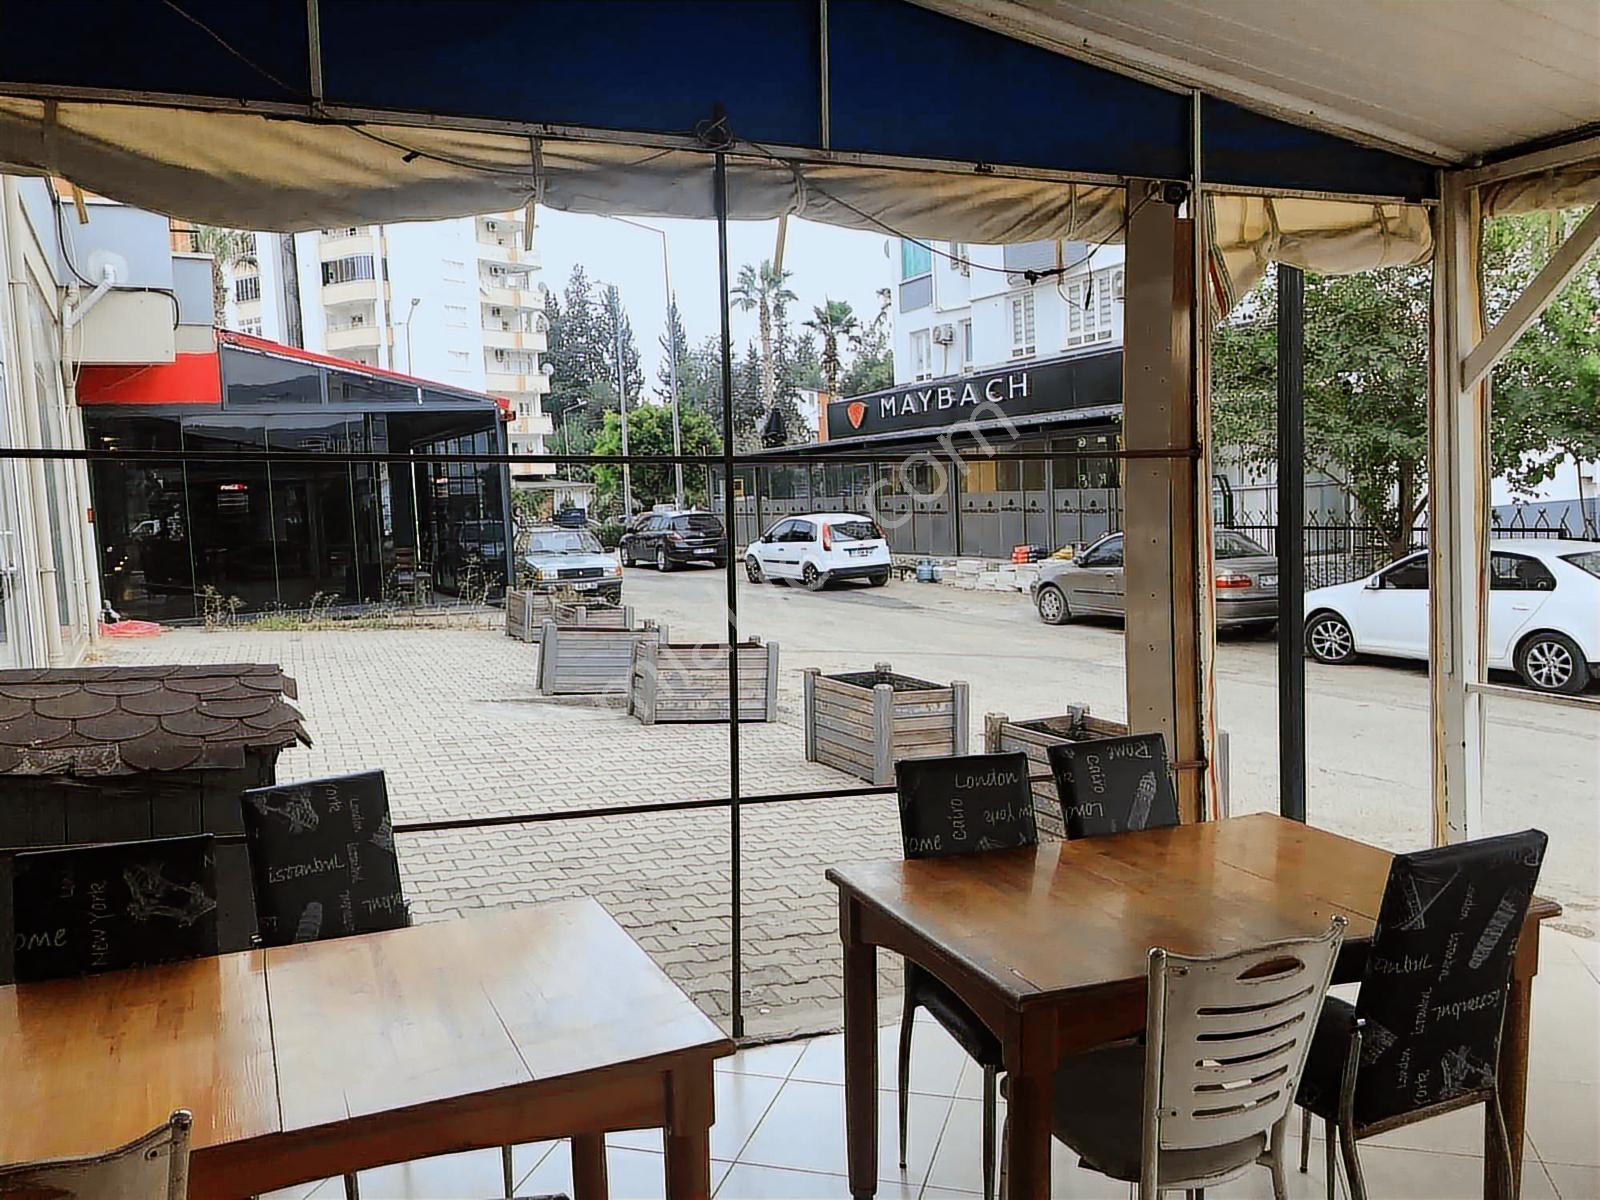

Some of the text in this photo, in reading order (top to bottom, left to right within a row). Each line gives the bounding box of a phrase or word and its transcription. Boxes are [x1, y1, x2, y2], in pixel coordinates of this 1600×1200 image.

[879, 372, 1028, 418] MAYBACH
[954, 768, 1019, 789] London
[905, 834, 942, 852] ome
